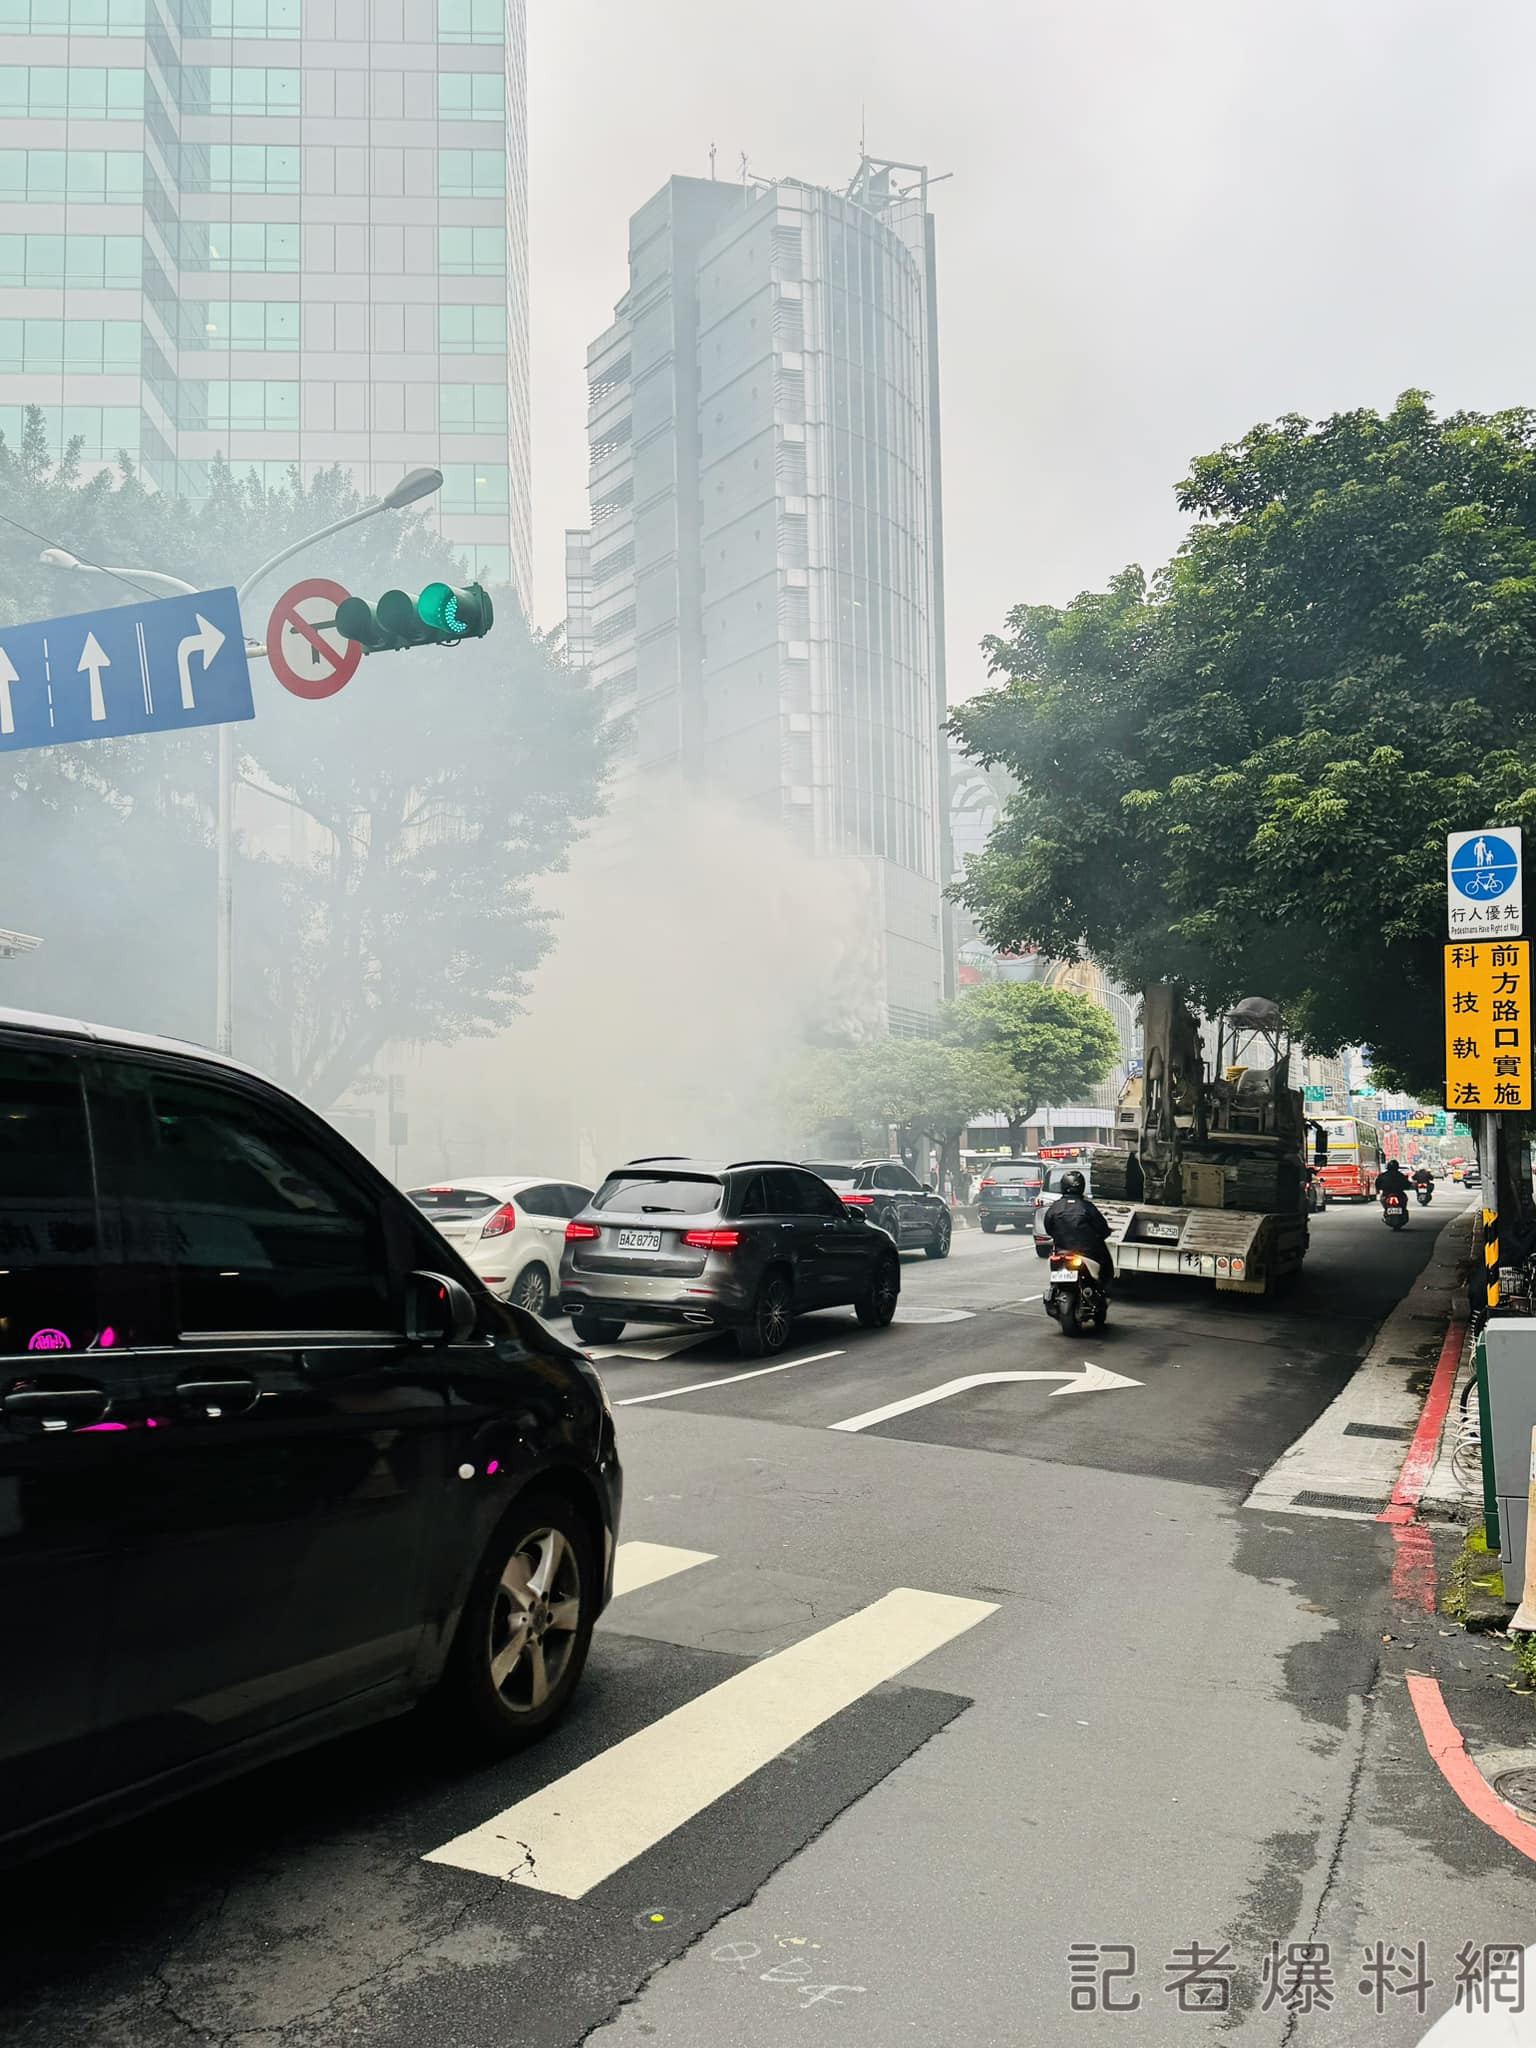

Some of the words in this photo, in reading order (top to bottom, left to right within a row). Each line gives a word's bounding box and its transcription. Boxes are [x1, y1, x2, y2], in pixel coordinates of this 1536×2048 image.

[1451, 904, 1520, 922] 行人優先
[1490, 923, 1503, 934] Right
[1451, 946, 1481, 1104] 科技執法
[1491, 944, 1522, 1105] 前方路口實施
